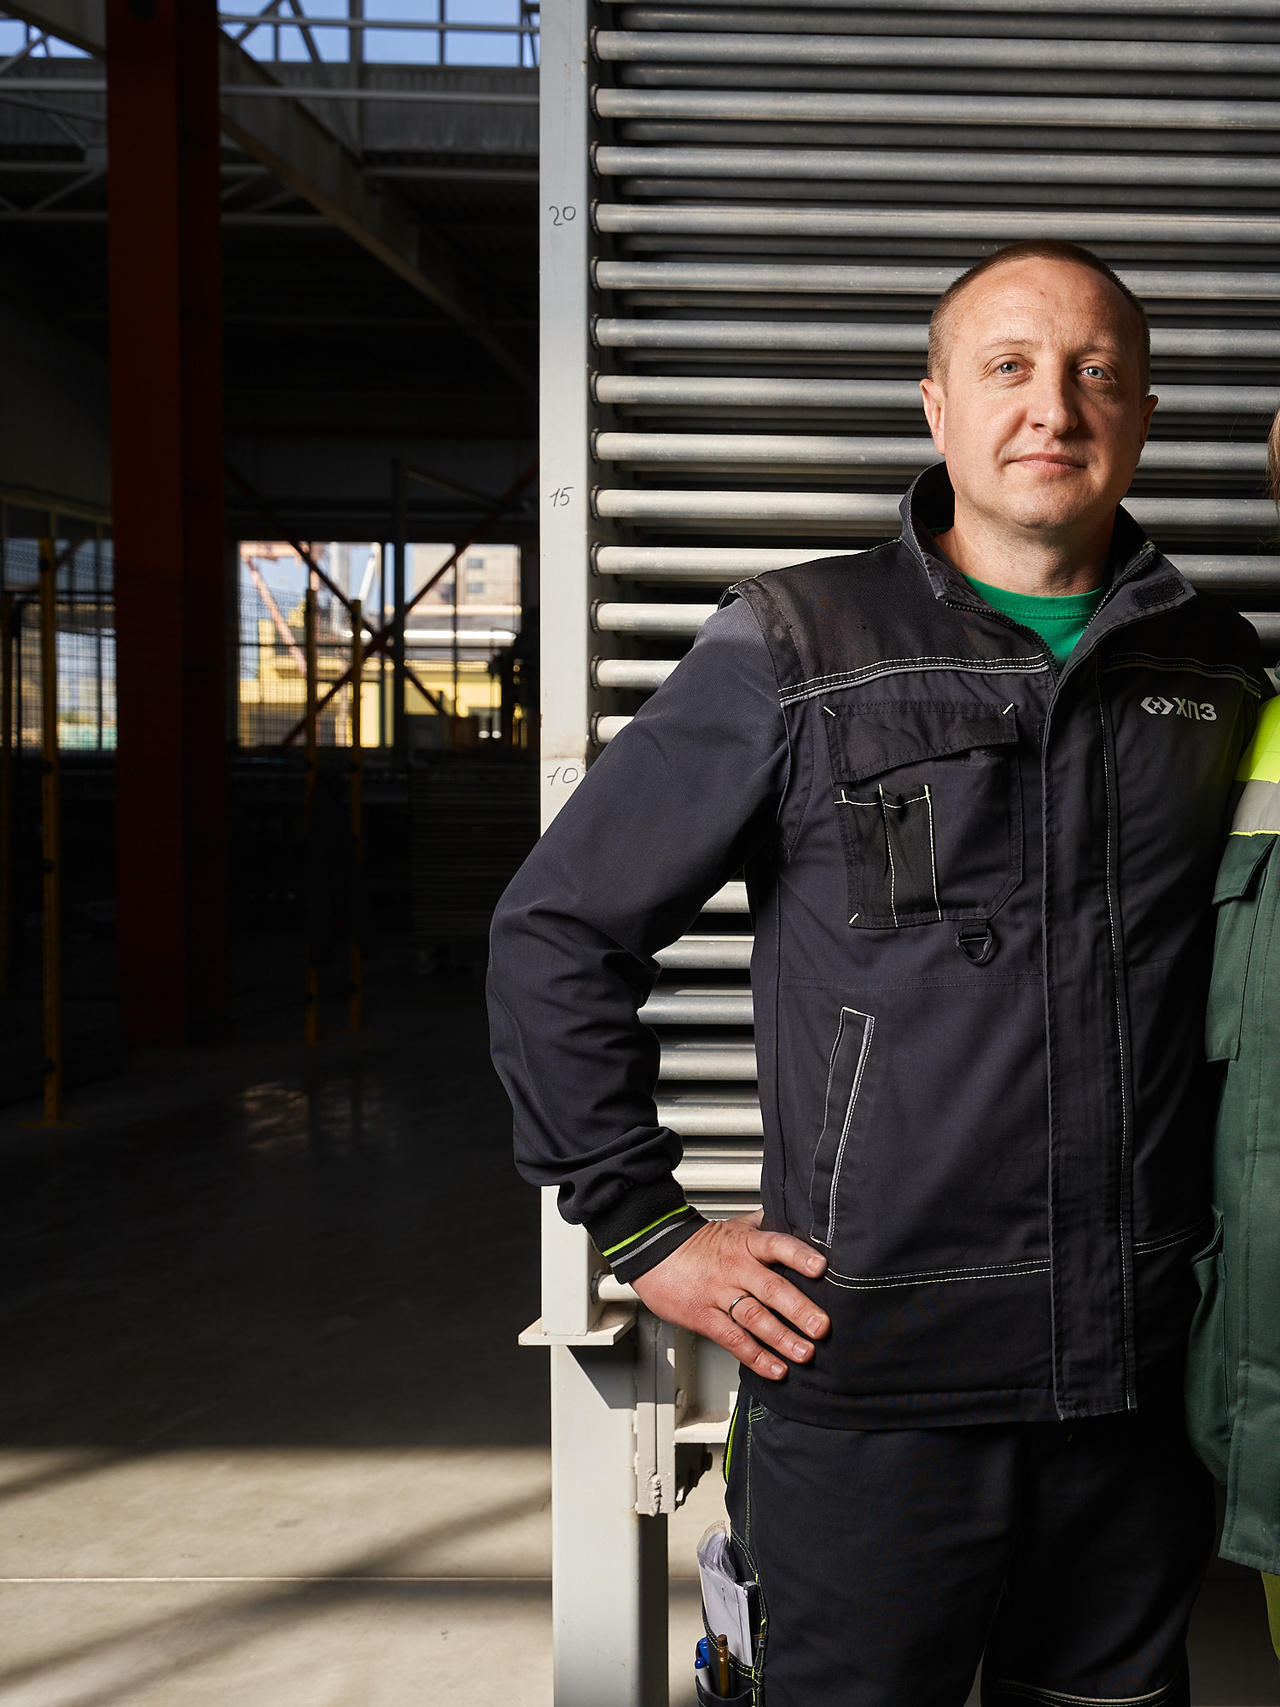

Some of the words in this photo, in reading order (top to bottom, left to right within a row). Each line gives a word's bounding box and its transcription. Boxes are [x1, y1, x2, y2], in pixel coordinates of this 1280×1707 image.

[548, 205, 576, 226] 20
[549, 486, 574, 508] 15
[1172, 696, 1218, 721] ХПЗ
[547, 766, 579, 786] 10
